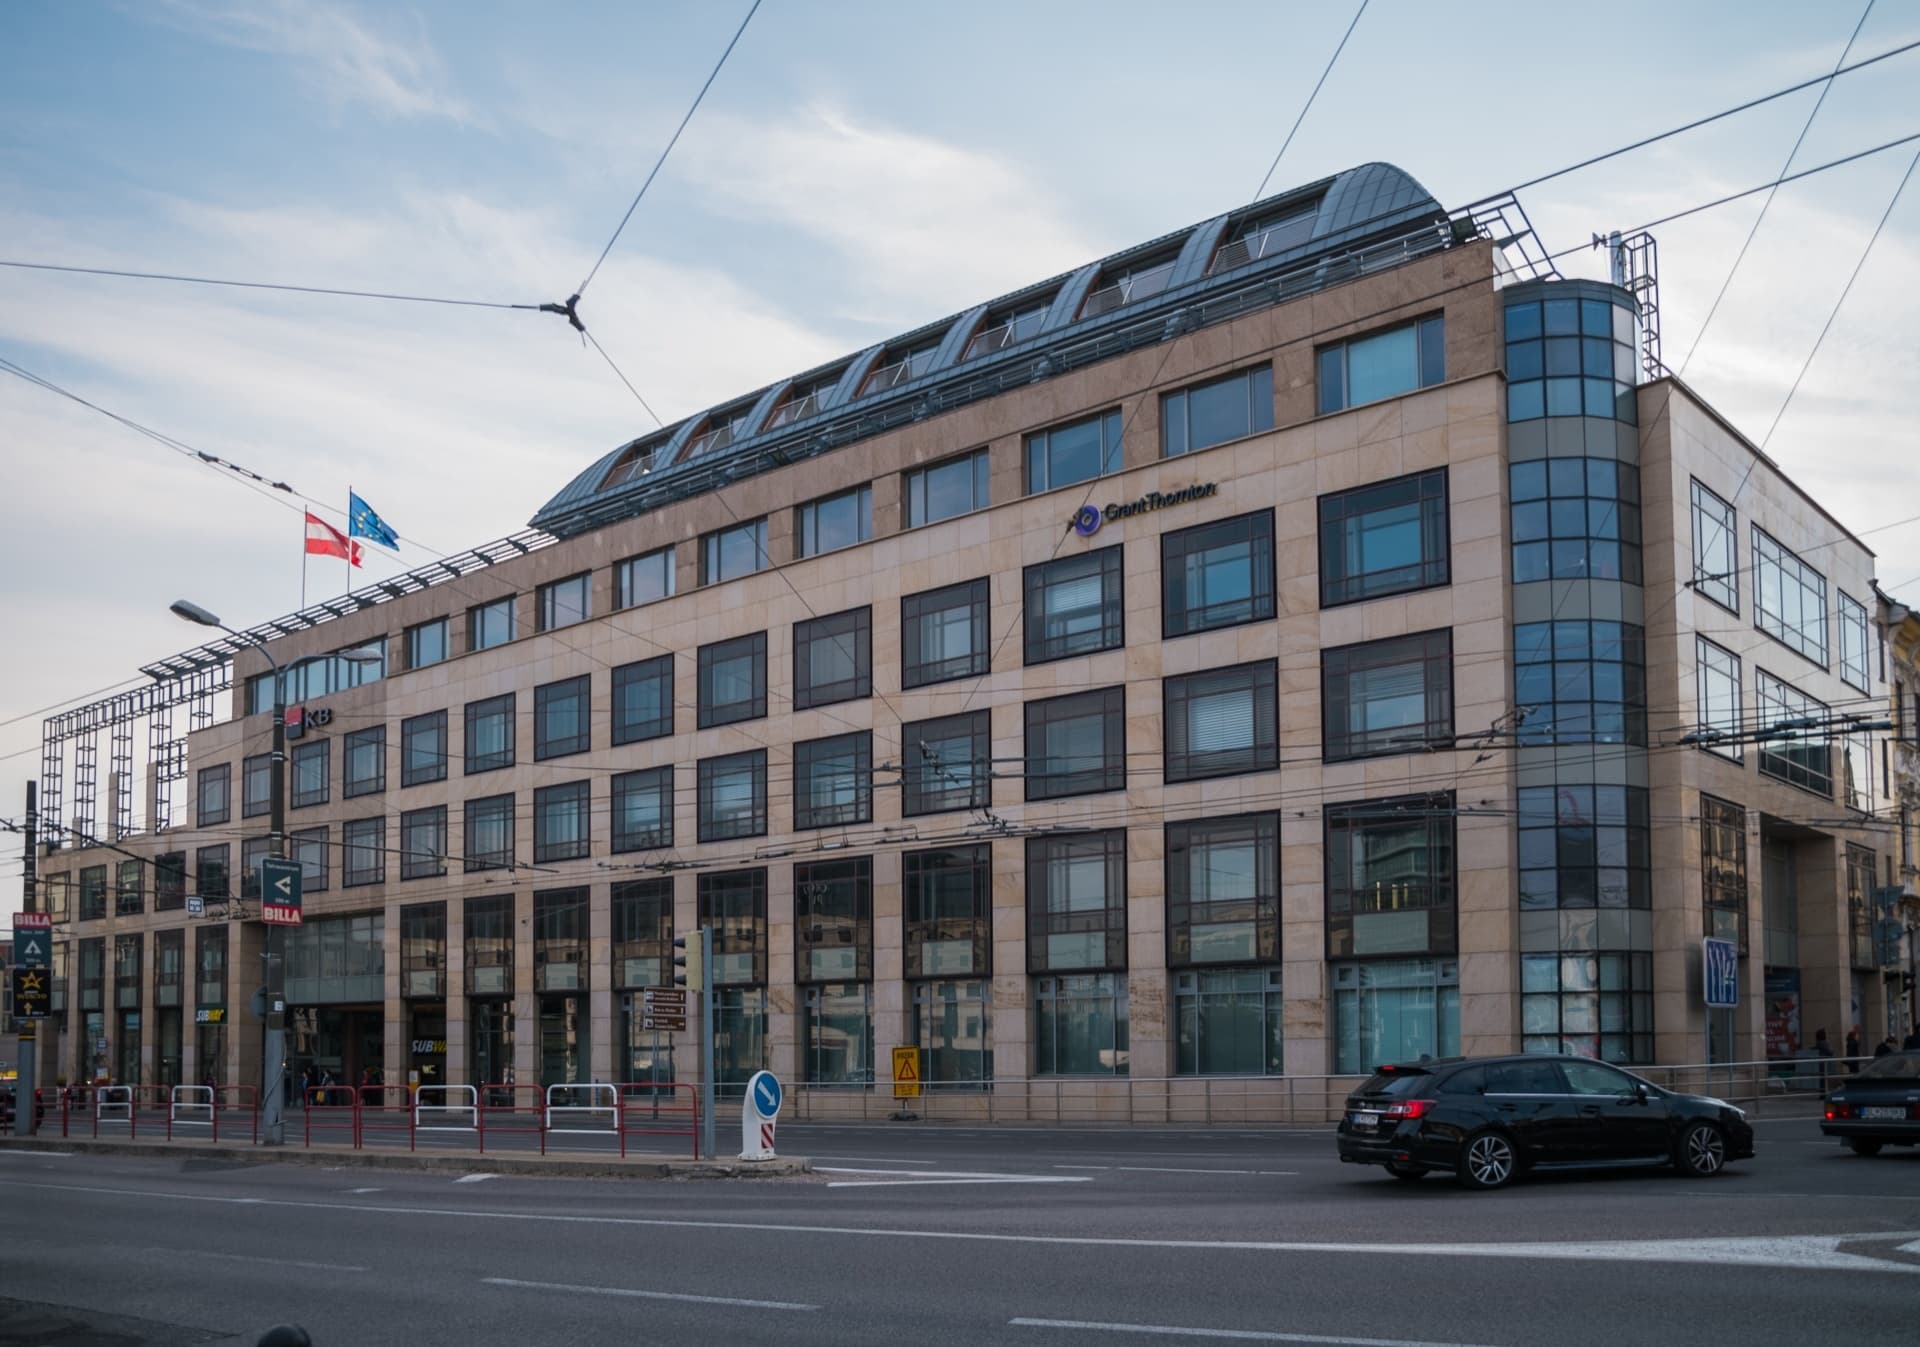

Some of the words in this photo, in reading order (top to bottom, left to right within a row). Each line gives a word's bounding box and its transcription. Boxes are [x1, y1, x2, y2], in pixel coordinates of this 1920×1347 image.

[1104, 497, 1146, 520] Grant
[1146, 482, 1218, 510] Thornton
[305, 708, 332, 728] KB
[15, 914, 50, 926] BILLA
[264, 907, 300, 923] BILLA
[196, 1009, 225, 1022] SUBWAY
[412, 1040, 448, 1054] SUBW
